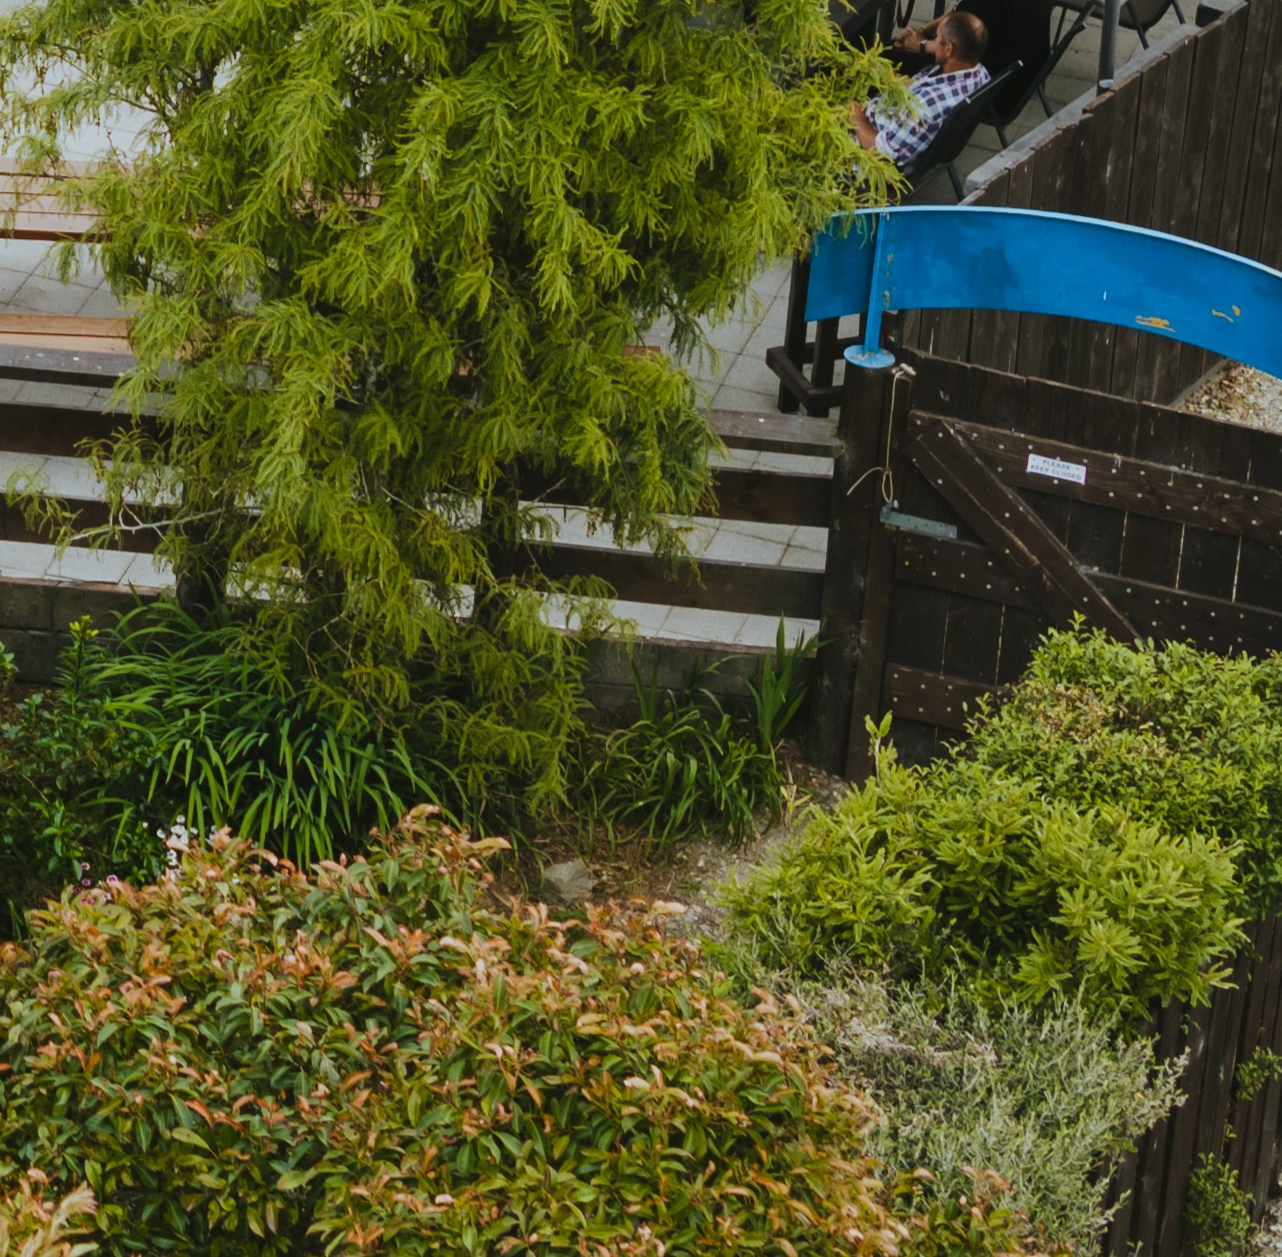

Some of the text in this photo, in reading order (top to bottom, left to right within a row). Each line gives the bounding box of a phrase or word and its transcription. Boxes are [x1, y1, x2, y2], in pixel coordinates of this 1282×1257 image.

[1030, 463, 1082, 481] KEEP CLOSED
[1042, 458, 1071, 471] PLEASE
